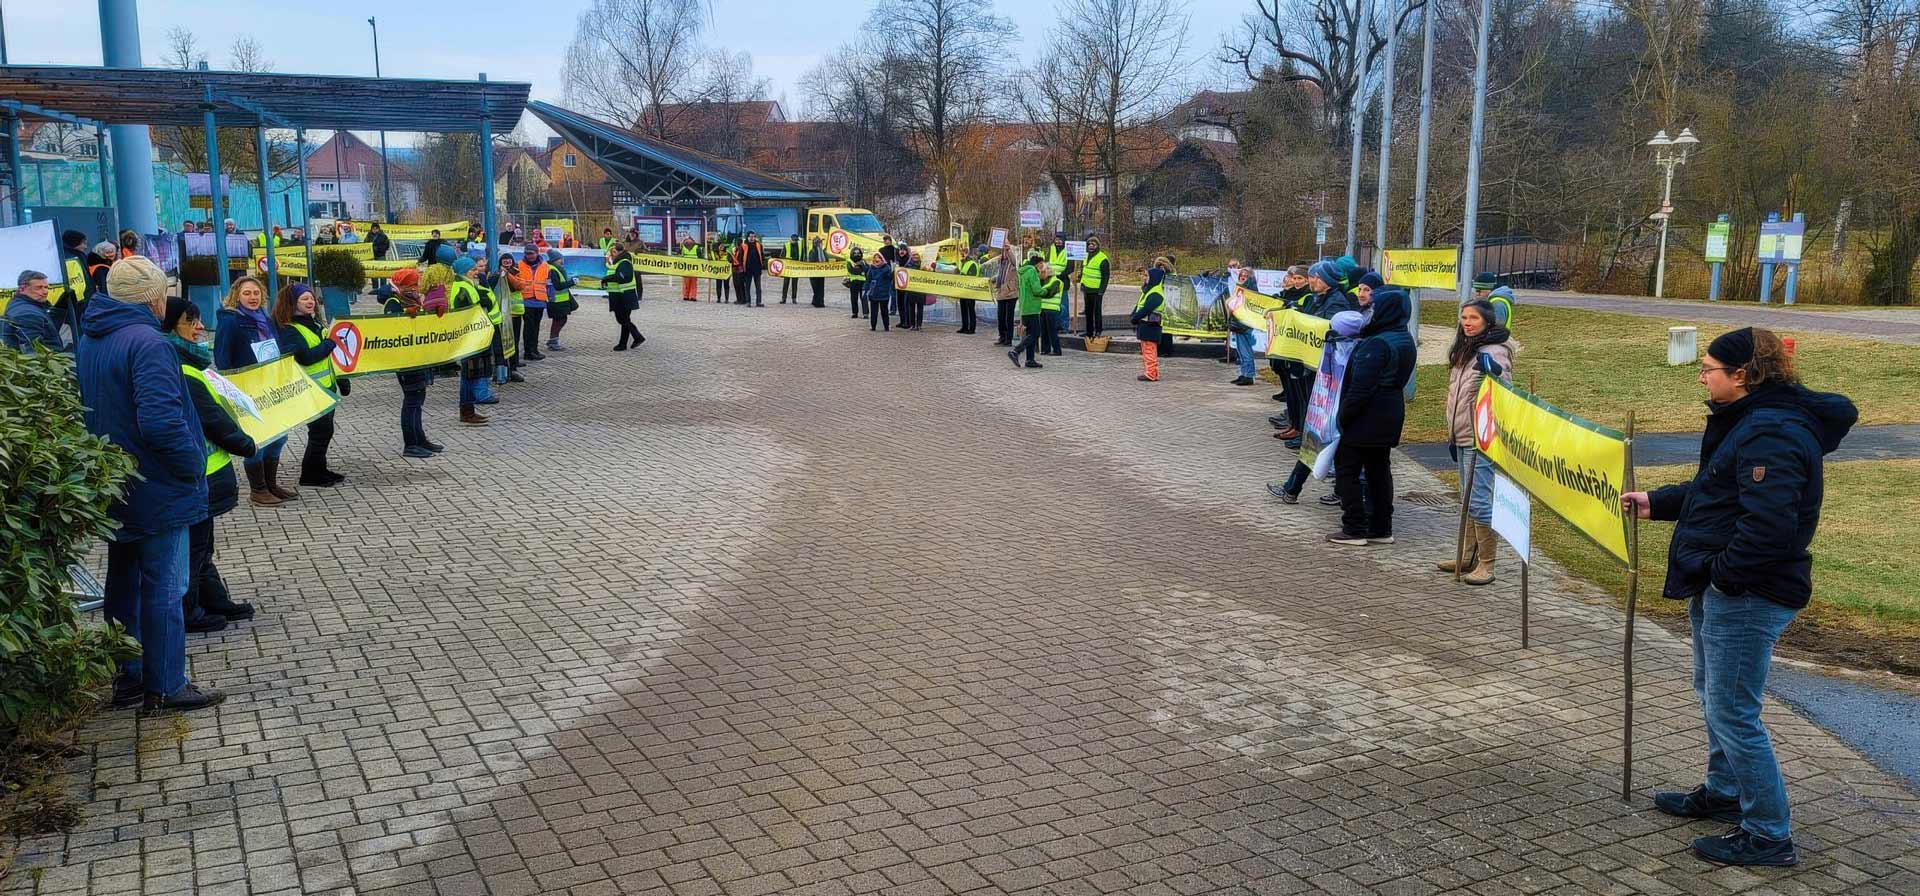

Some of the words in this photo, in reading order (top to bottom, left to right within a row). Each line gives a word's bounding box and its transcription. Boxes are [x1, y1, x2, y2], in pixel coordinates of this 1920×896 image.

[363, 333, 413, 350] Infraschall
[415, 332, 430, 345] und
[1537, 455, 1554, 481] vor
